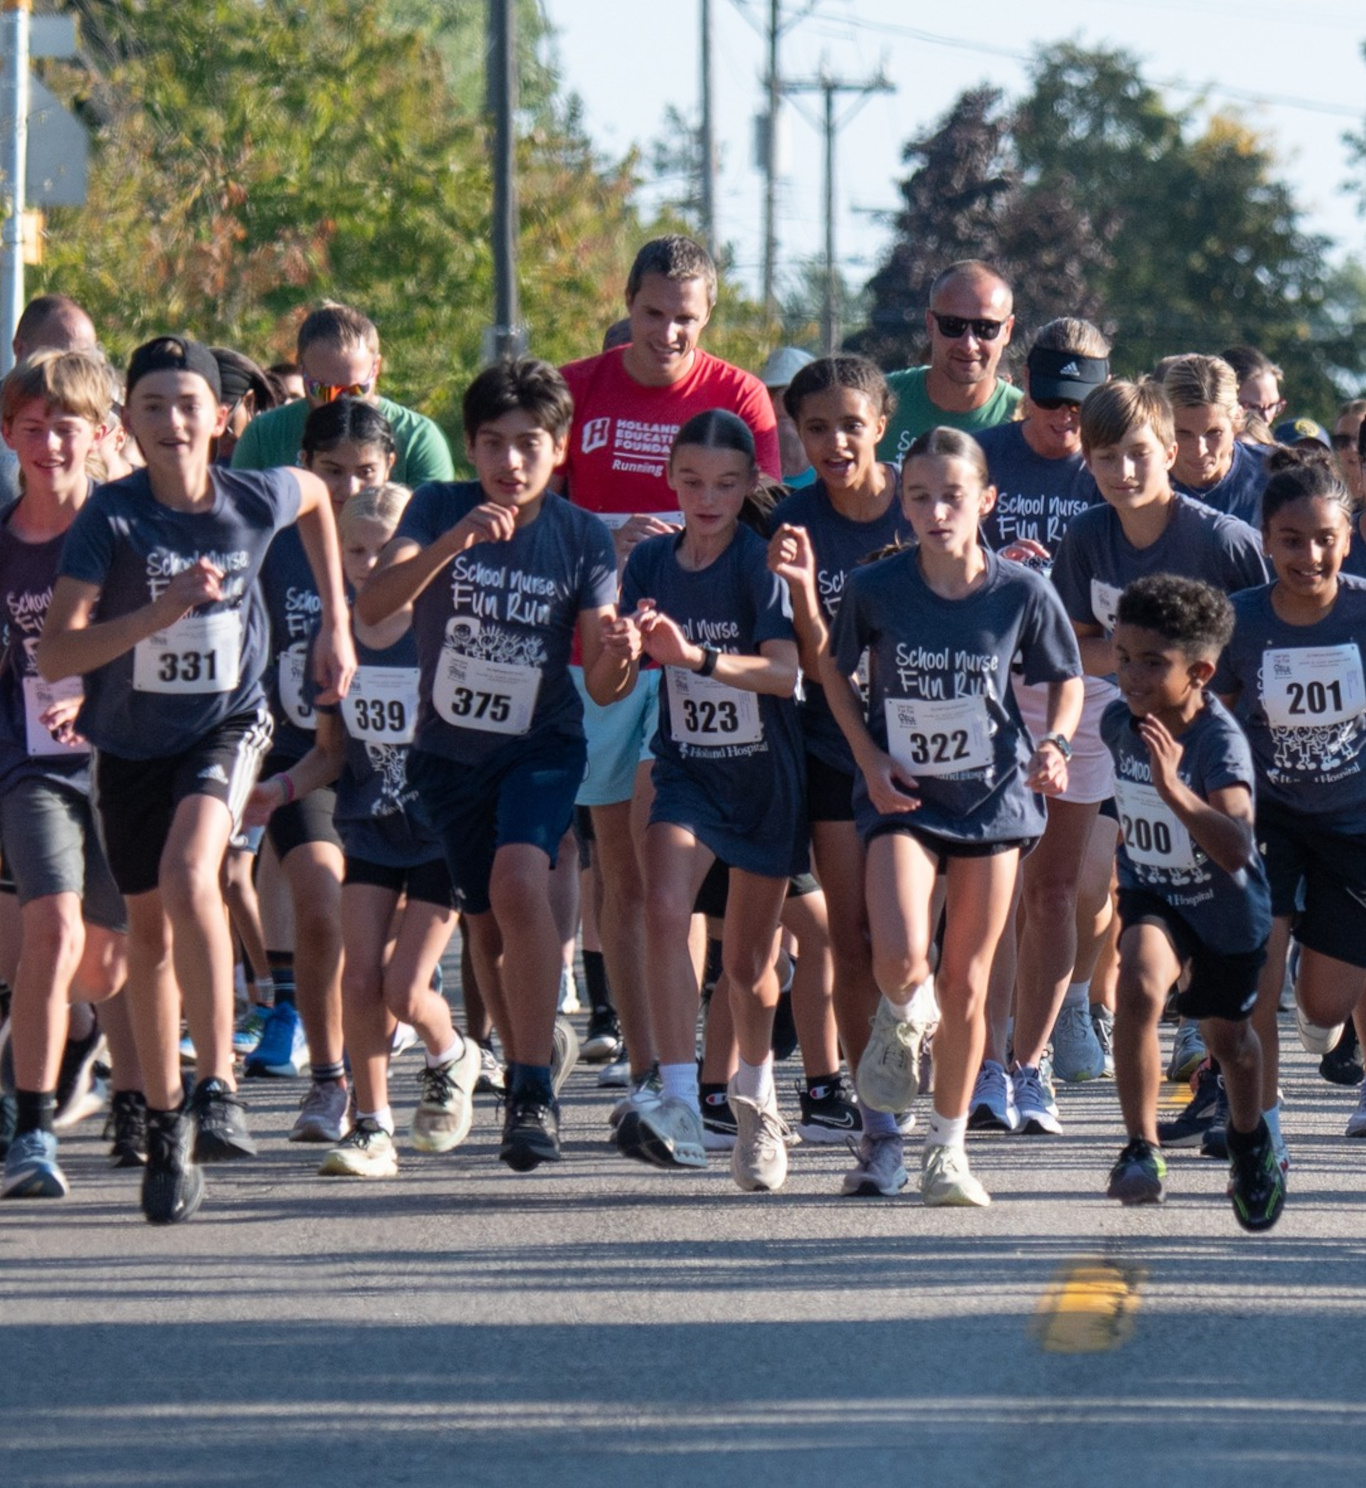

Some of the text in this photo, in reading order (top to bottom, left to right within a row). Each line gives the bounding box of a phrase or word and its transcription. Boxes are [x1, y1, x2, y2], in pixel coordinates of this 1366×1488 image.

[614, 439, 671, 454] FOUNDA
[615, 429, 675, 445] EDUCATI
[612, 459, 663, 477] Running
[997, 492, 1045, 516] School
[452, 556, 506, 590] School
[451, 583, 551, 626] Fun Run
[159, 650, 217, 682] 331
[896, 642, 949, 671] School
[896, 668, 944, 700] Fun
[1286, 680, 1343, 715] 201
[354, 699, 406, 732] 339
[450, 687, 512, 723] 375
[683, 699, 739, 733] 323
[910, 729, 971, 765] 322
[1121, 814, 1172, 855] 200
